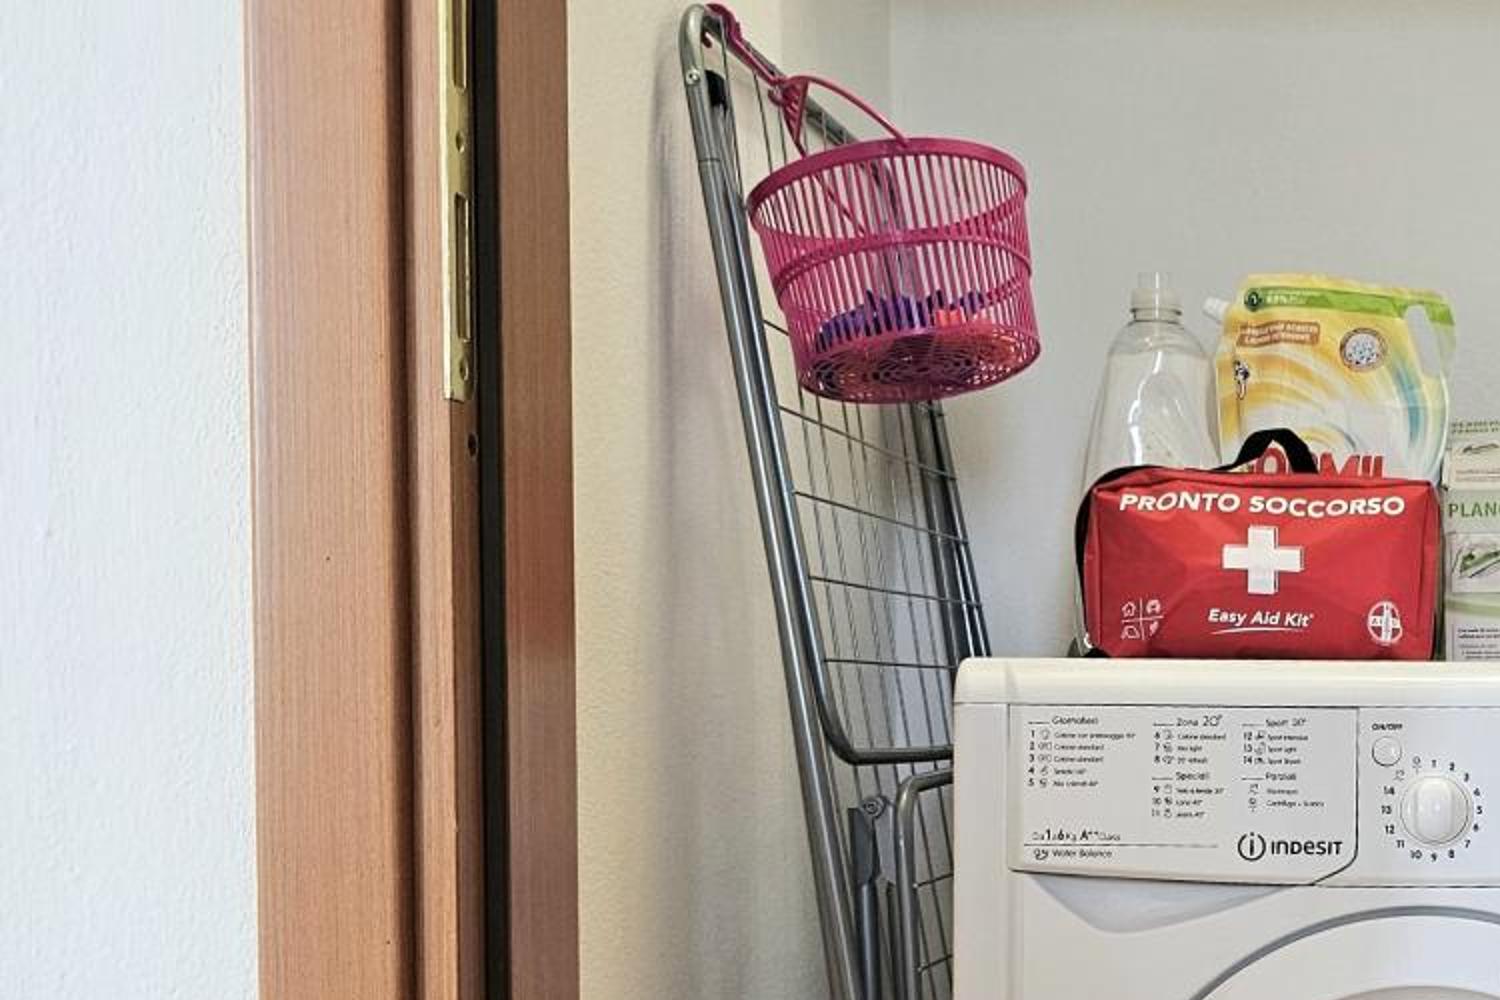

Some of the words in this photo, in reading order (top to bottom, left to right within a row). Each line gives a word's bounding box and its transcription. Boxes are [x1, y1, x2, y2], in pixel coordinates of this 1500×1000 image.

[1119, 491, 1241, 512] PRONTO
[1248, 495, 1406, 518] SOCCORSO
[1208, 608, 1248, 627] Easy
[1250, 610, 1281, 625] Aid
[1385, 823, 1396, 835] 12
